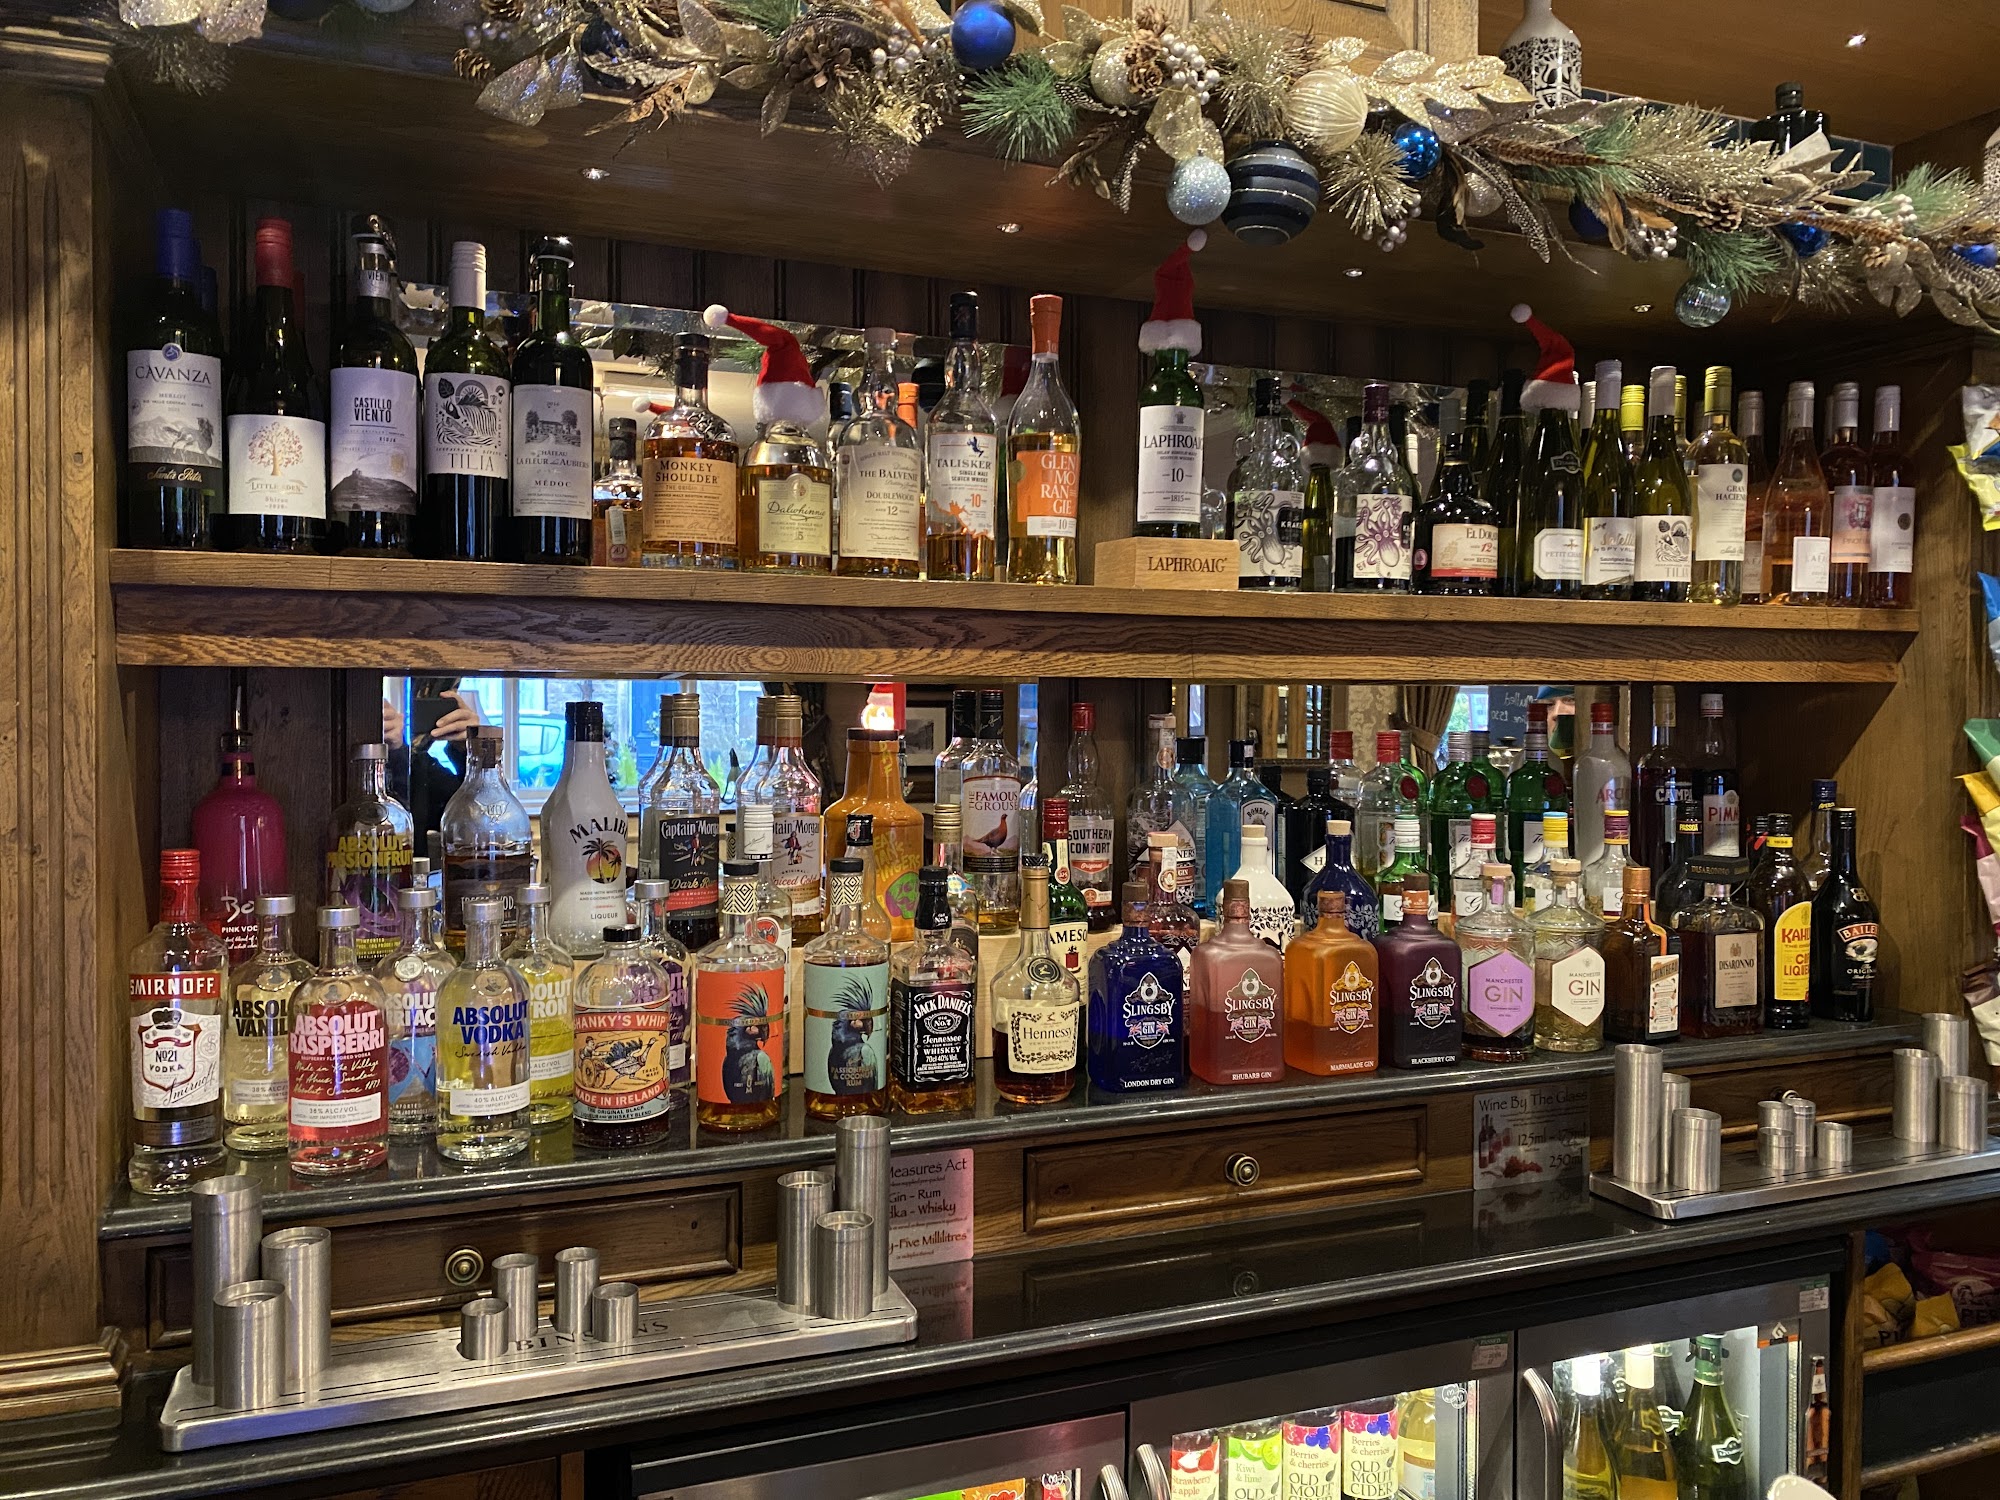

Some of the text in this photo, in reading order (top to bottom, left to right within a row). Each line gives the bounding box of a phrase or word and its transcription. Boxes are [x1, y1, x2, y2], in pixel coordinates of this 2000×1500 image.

[135, 365, 211, 385] CAVANZA
[354, 397, 392, 411] CASTILLO
[354, 408, 392, 423] VIENTO
[449, 453, 494, 472] TILIA
[660, 460, 713, 473] MONKEY
[935, 459, 992, 469] TALISKER
[1041, 454, 1077, 470] GLEN
[148, 465, 176, 482] Santa
[655, 473, 718, 484] SHOULDER
[879, 469, 917, 481] BALVENIE
[1055, 472, 1077, 486] MO
[1171, 468, 1184, 483] 10
[251, 482, 277, 491] LITTLE
[1041, 484, 1069, 499] RAN
[866, 491, 914, 501] DOUBLEWOOD
[970, 494, 982, 508] 10
[767, 501, 826, 516] Dalwhinnie
[887, 506, 898, 516] 12
[1053, 500, 1073, 515] GIE
[1059, 522, 1068, 530] 10
[1467, 528, 1477, 538] EL
[1481, 543, 1493, 552] 12
[1148, 557, 1226, 573] LAPHROAIG
[976, 791, 1018, 801] FAMOUS
[975, 802, 1018, 811] GROUSE
[1247, 807, 1269, 818] BOMBAY
[661, 821, 695, 839] Captain
[1068, 829, 1112, 840] SOUTHERN
[338, 835, 405, 851] ABSOLUT
[1070, 842, 1110, 854] COMFORT
[670, 878, 699, 889] Dark
[591, 912, 618, 920] LIQUEUR
[1782, 928, 1809, 943] KAHL
[1719, 958, 1754, 971] DISARONNO
[130, 977, 215, 996] SMIRNOFF
[1410, 983, 1456, 1000] SLINGSBY
[1568, 979, 1600, 996] GIN
[1330, 986, 1374, 1006] SLINGSBY
[1485, 986, 1522, 1003] GIN
[233, 1000, 289, 1019] ABSOL
[914, 995, 972, 1019] JACK DANIEL'S
[1123, 999, 1175, 1019] SLINGSBY
[1225, 995, 1277, 1014] SLINGSBY
[1427, 1006, 1438, 1015] GIN
[453, 1000, 529, 1025] ABSOLUT
[1346, 1010, 1356, 1020] GIN
[237, 1018, 288, 1037] VANIL
[296, 1010, 378, 1035] ABSOLUT
[636, 1016, 666, 1027] WHIP
[1243, 1019, 1257, 1028] GIN
[461, 1022, 524, 1044] VODKA
[1023, 1026, 1072, 1041] Hennessy
[1142, 1025, 1155, 1034] GIN
[290, 1027, 385, 1055] RASPBERRI
[923, 1034, 962, 1044] Tennessee
[354, 1052, 371, 1060] VODKA
[455, 1046, 500, 1058] Swedish
[923, 1046, 961, 1055] WHISKEY
[351, 1058, 379, 1072] Village
[534, 1060, 561, 1068] ALC/VOL
[926, 1054, 949, 1063] 70cl 40%
[1411, 1056, 1445, 1064] BLACKBERRY
[150, 1063, 184, 1073] VODKA
[1331, 1062, 1363, 1071] MARMALADE
[840, 1071, 873, 1080] COCONUT
[1232, 1071, 1272, 1080] RHUBARB GIN
[164, 1064, 217, 1105] Smirnoff
[1124, 1079, 1149, 1088] LONDON
[1163, 1077, 1174, 1085] GIN
[491, 1094, 518, 1102] ALC/VOL
[575, 1084, 660, 1106] MADE IN IRELAND
[1479, 1088, 1588, 1112] Wine By The Glass
[325, 1106, 358, 1114] ALC/VOL
[1518, 1127, 1546, 1146] 125ml
[1549, 1147, 1582, 1168] 250ml
[945, 1158, 967, 1172] Act
[918, 1189, 941, 1200] Rum
[918, 1199, 956, 1216] Whisky
[922, 1230, 967, 1246] Millilitres
[1352, 1436, 1380, 1446] Berries
[1290, 1448, 1319, 1459] Berries
[1360, 1446, 1390, 1456] cherries
[1236, 1463, 1256, 1473] Kiwi
[1298, 1459, 1330, 1469] cherries
[1351, 1459, 1380, 1473] OLD
[1244, 1474, 1262, 1484] lime
[1289, 1472, 1319, 1486] OLD
[1351, 1469, 1394, 1485] MOUT
[1179, 1486, 1200, 1497] apple
[1235, 1488, 1265, 1500] OLD
[1290, 1482, 1334, 1498] MOUT
[1350, 1481, 1393, 1496] CIDER
